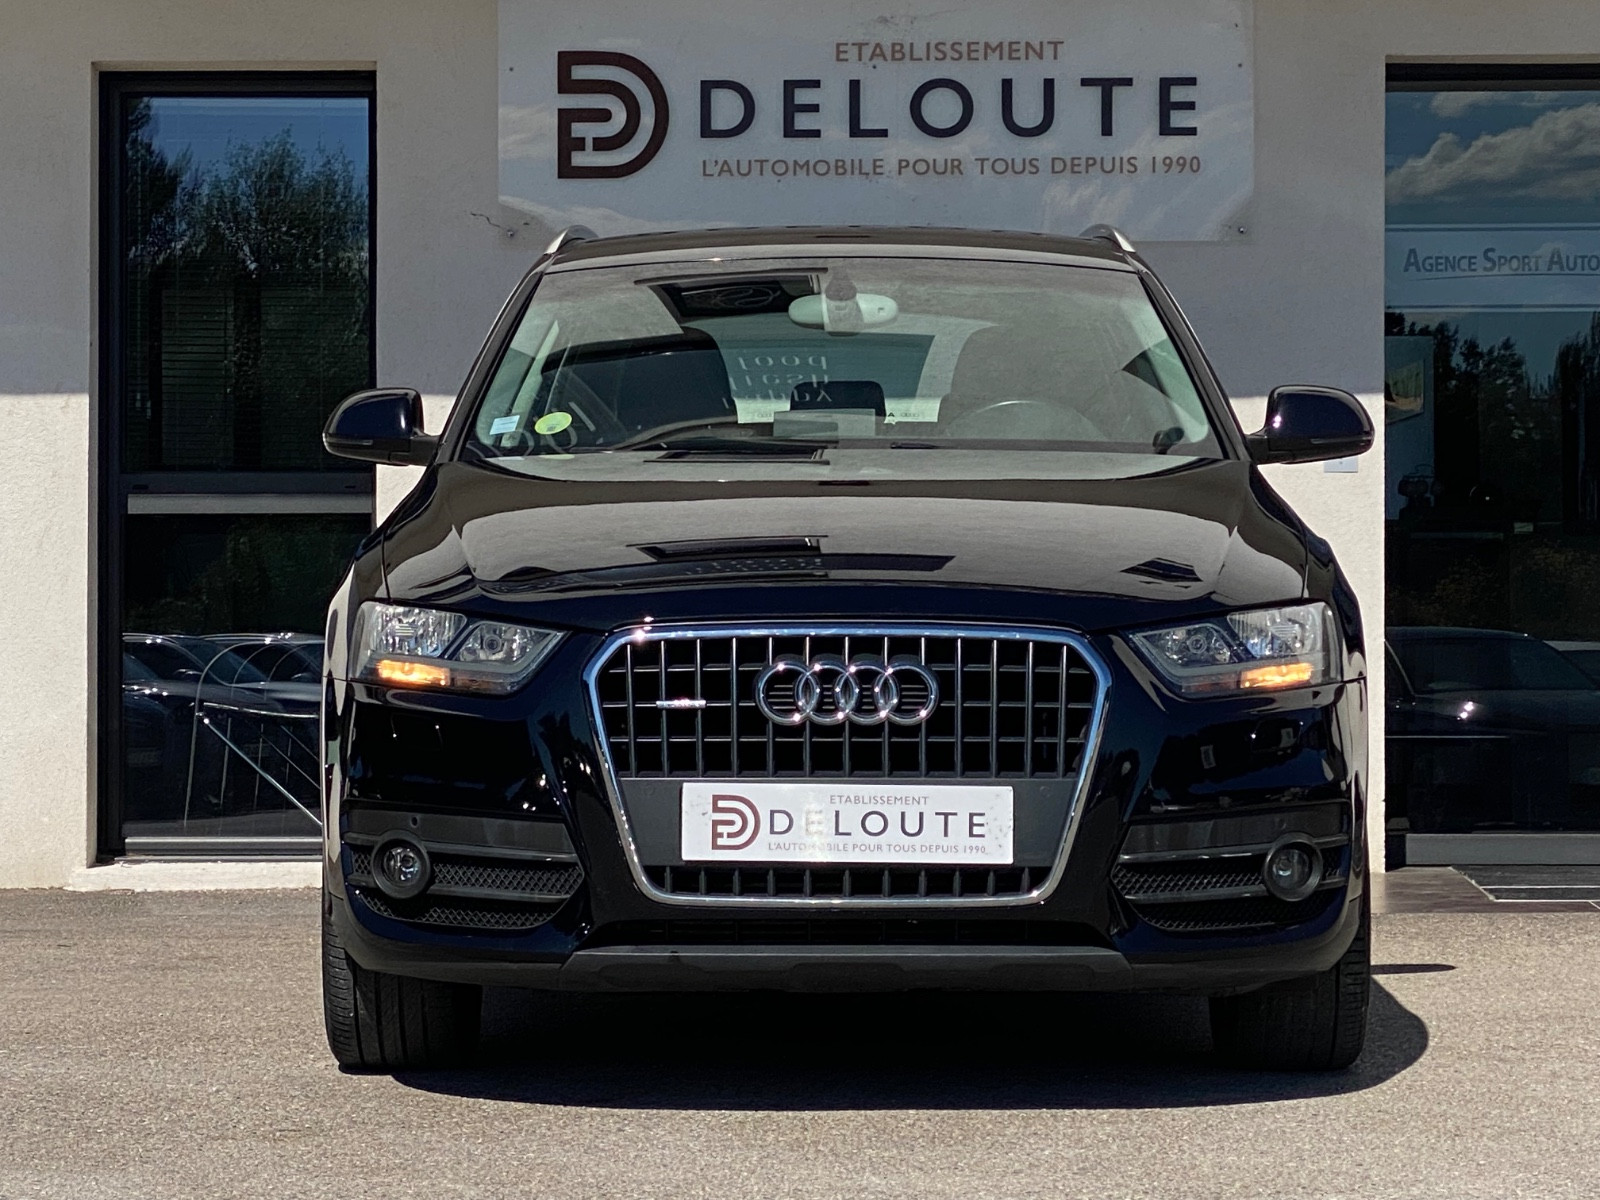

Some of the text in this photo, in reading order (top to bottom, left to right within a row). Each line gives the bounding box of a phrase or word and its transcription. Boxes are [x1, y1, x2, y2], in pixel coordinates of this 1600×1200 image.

[835, 40, 1065, 63] ETABLISSEMENT
[700, 76, 1198, 139] DELOUTE
[702, 155, 1202, 179] L'AUTOMOBILE POUR TOUS DEPUIS 1990
[829, 794, 930, 806] ETABLISSEMENT
[769, 809, 986, 838] DELOUTE
[852, 843, 884, 853] POUR
[887, 844, 917, 853] TOUS
[920, 845, 959, 854] DEPUIS
[963, 845, 987, 855] 1990
